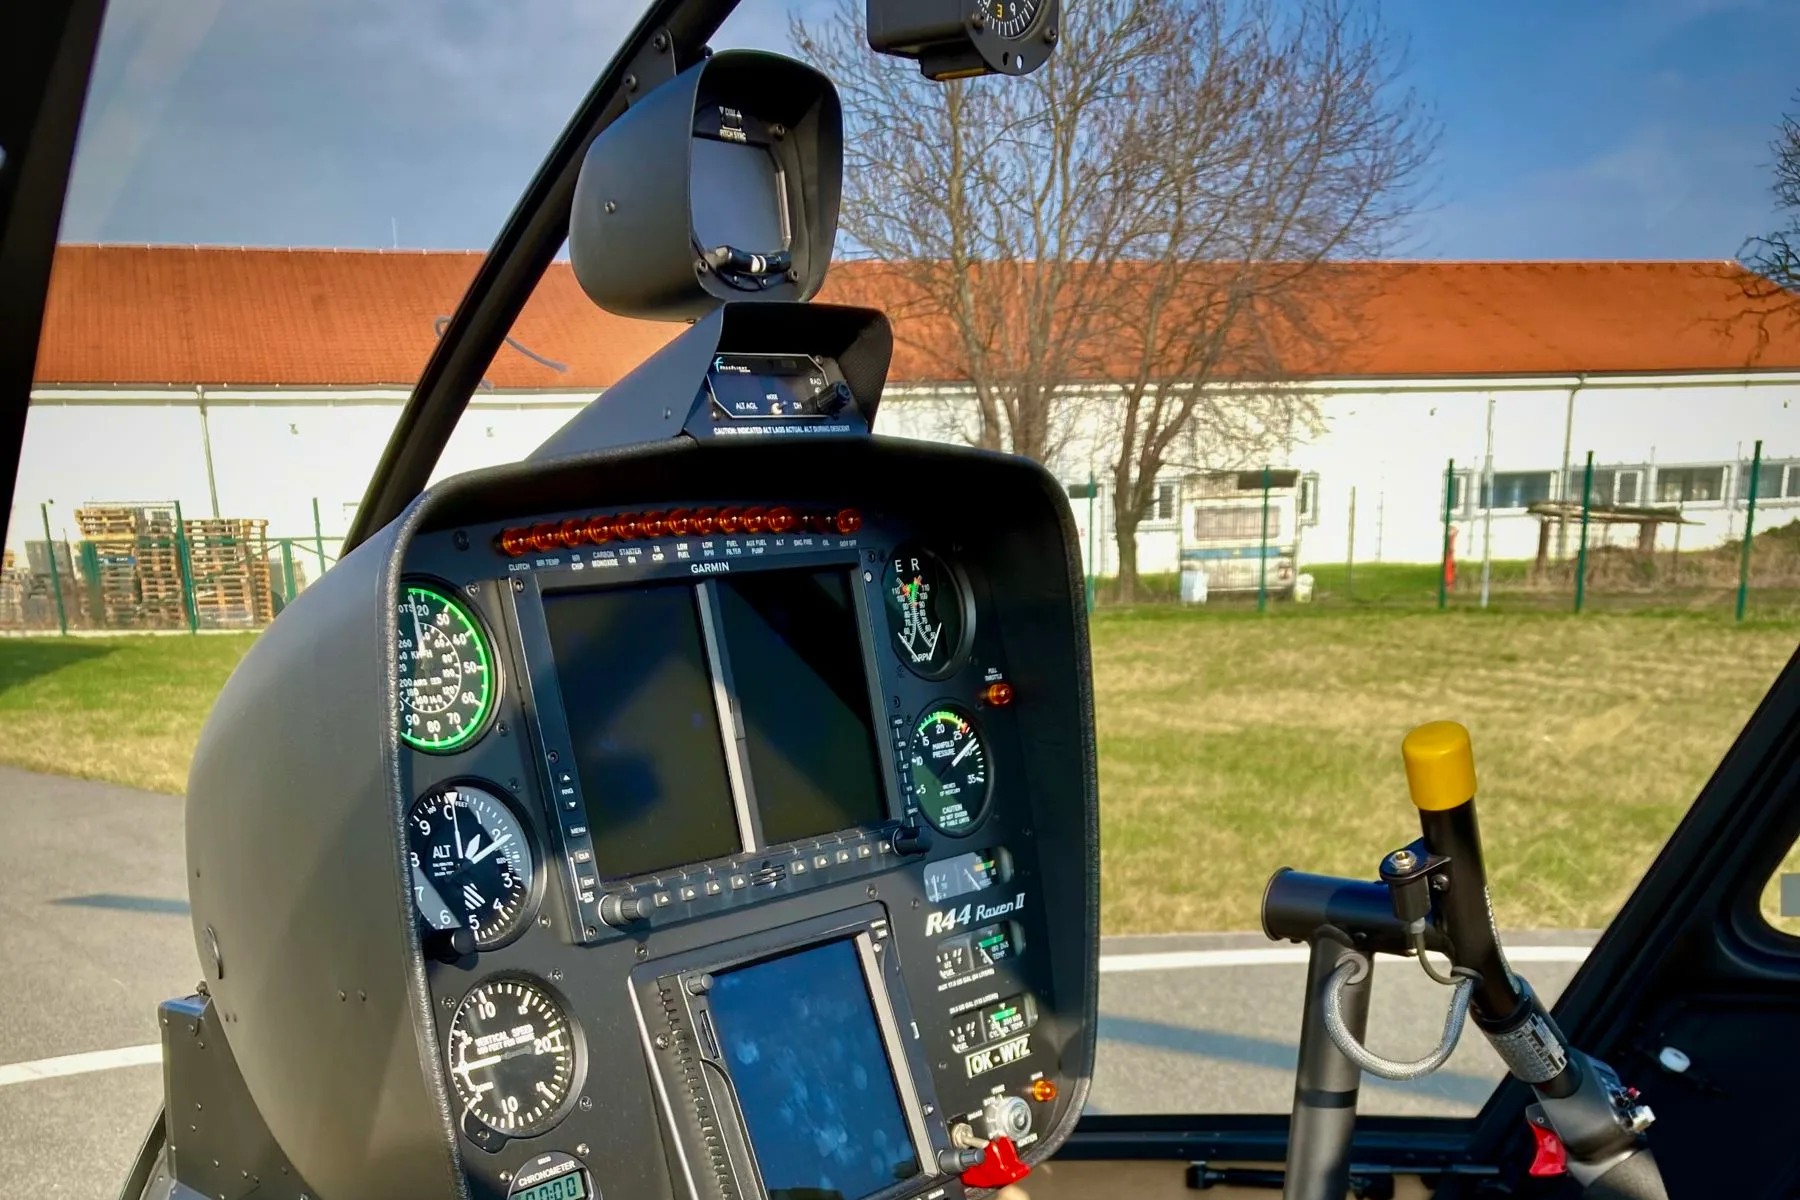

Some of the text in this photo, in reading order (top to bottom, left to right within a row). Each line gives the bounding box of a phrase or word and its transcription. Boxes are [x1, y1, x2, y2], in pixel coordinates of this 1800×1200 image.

[726, 540, 738, 548] FUEL
[592, 551, 615, 559] CARBON
[619, 548, 642, 556] STARTER
[677, 551, 690, 559] FUEL
[509, 563, 531, 572] CLUTCH
[690, 562, 730, 574] GARMIN
[895, 559, 904, 573] E
[911, 558, 920, 571] R
[417, 604, 429, 616] 20
[436, 613, 450, 626] 30
[452, 633, 467, 646] 40
[463, 661, 477, 674] 50
[461, 691, 476, 705] 60
[405, 713, 420, 726] 90
[447, 712, 461, 725] 70
[426, 720, 441, 733] 80
[936, 724, 945, 734] 20
[922, 736, 930, 746] 15
[953, 731, 963, 741] 25
[932, 740, 954, 750] MANIFOLD
[932, 748, 956, 758] PRESSURE
[916, 756, 924, 766] 10
[967, 774, 977, 784] 35
[921, 784, 926, 794] 5
[942, 804, 963, 813] CAUTION
[419, 820, 431, 836] 9
[570, 826, 586, 834] MENU
[492, 828, 501, 842] 2
[432, 845, 451, 859] ALT
[501, 873, 513, 888] 3
[414, 887, 424, 901] 7
[493, 898, 503, 911] 4
[440, 909, 451, 925] 6
[925, 892, 1026, 937] R44 Raven II
[469, 914, 480, 930] 5
[478, 1002, 496, 1020] 10
[475, 1031, 509, 1047] VERTICAL
[511, 1024, 534, 1038] SPEED
[534, 1037, 551, 1055] 20
[502, 1096, 519, 1115] 10
[518, 1160, 576, 1187] CHRONOMETER
